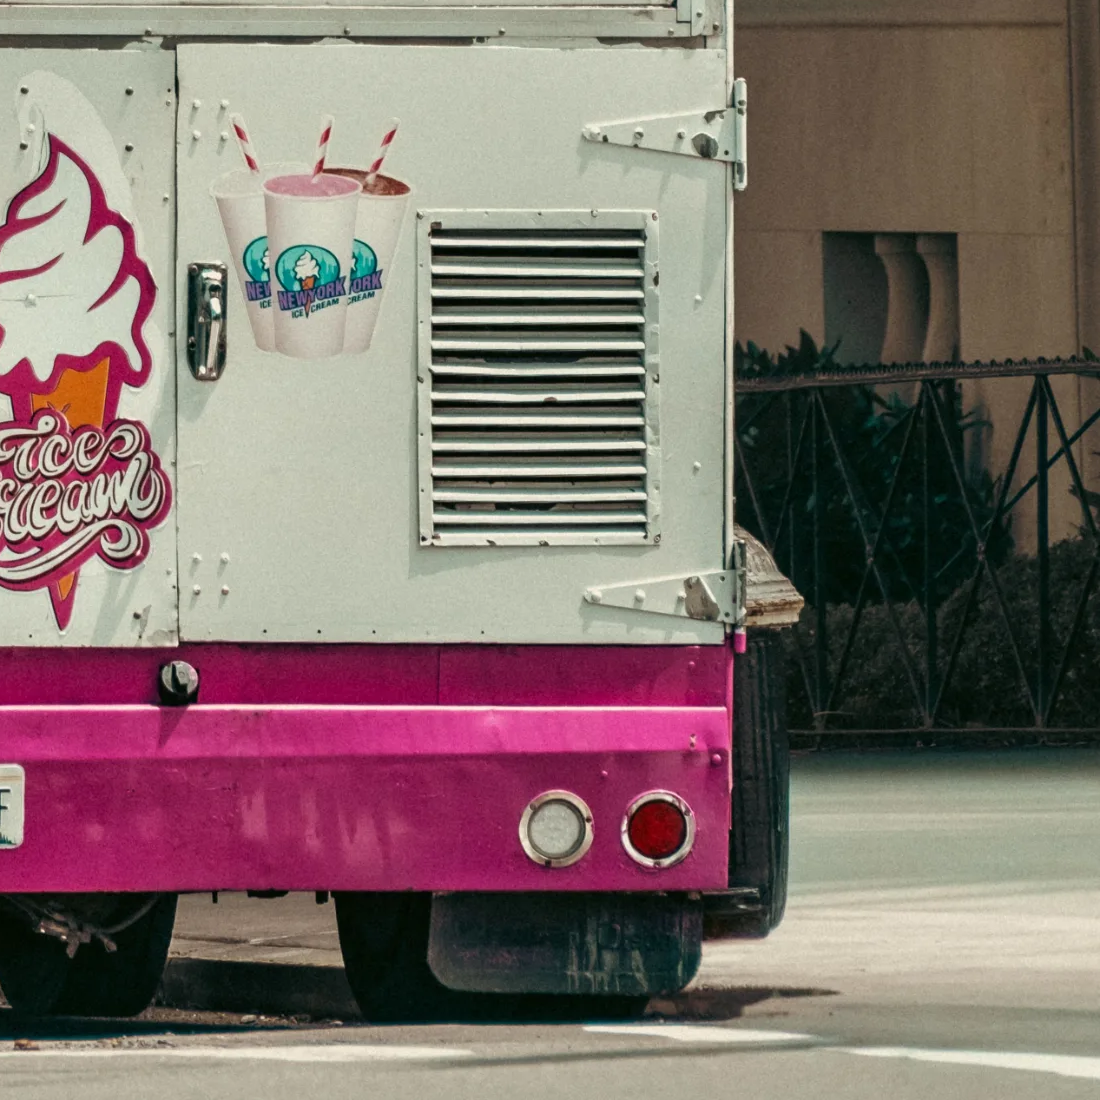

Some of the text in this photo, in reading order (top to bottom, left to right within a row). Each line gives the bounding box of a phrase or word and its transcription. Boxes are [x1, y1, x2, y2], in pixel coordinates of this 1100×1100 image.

[278, 276, 346, 311] NEW YORK
[292, 298, 340, 318] ICE CREAM
